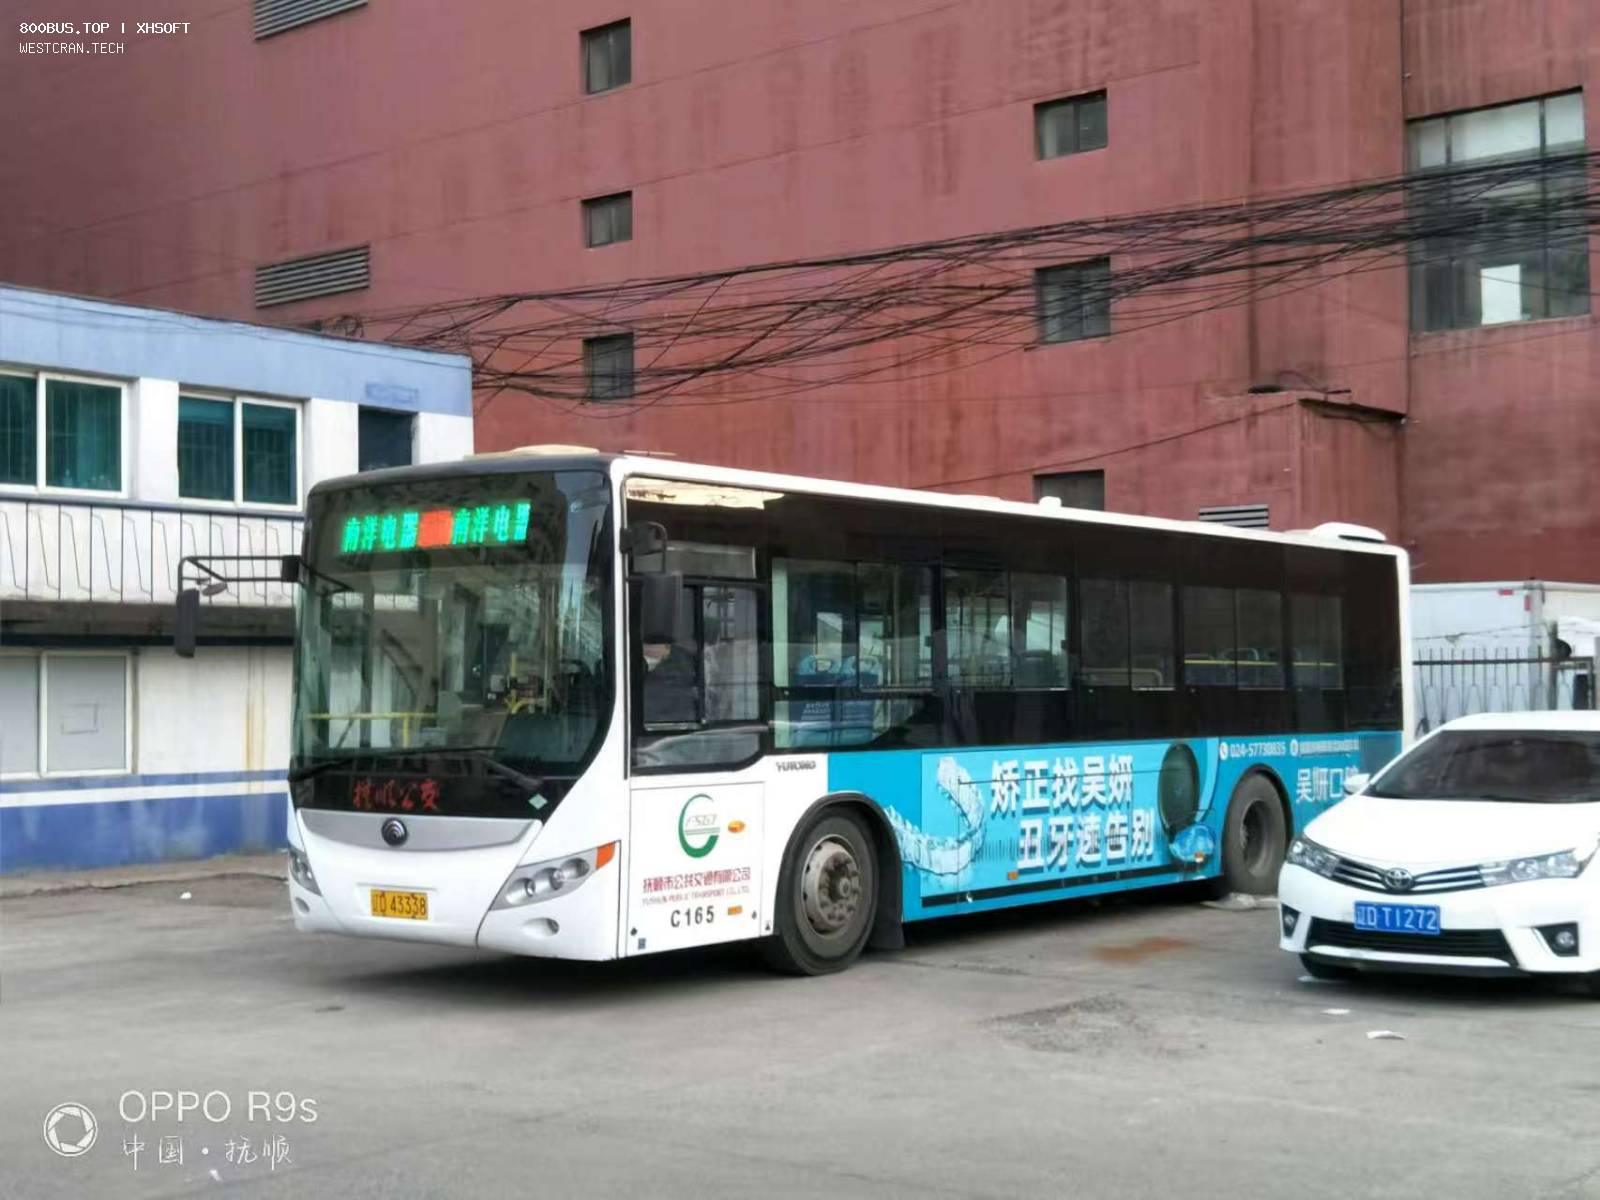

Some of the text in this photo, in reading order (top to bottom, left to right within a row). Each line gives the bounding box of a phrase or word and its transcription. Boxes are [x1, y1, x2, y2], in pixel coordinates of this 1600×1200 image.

[989, 754, 1134, 814] 矫正找吴妍
[1016, 807, 1156, 870] 丑牙速告别
[670, 905, 716, 928] C165
